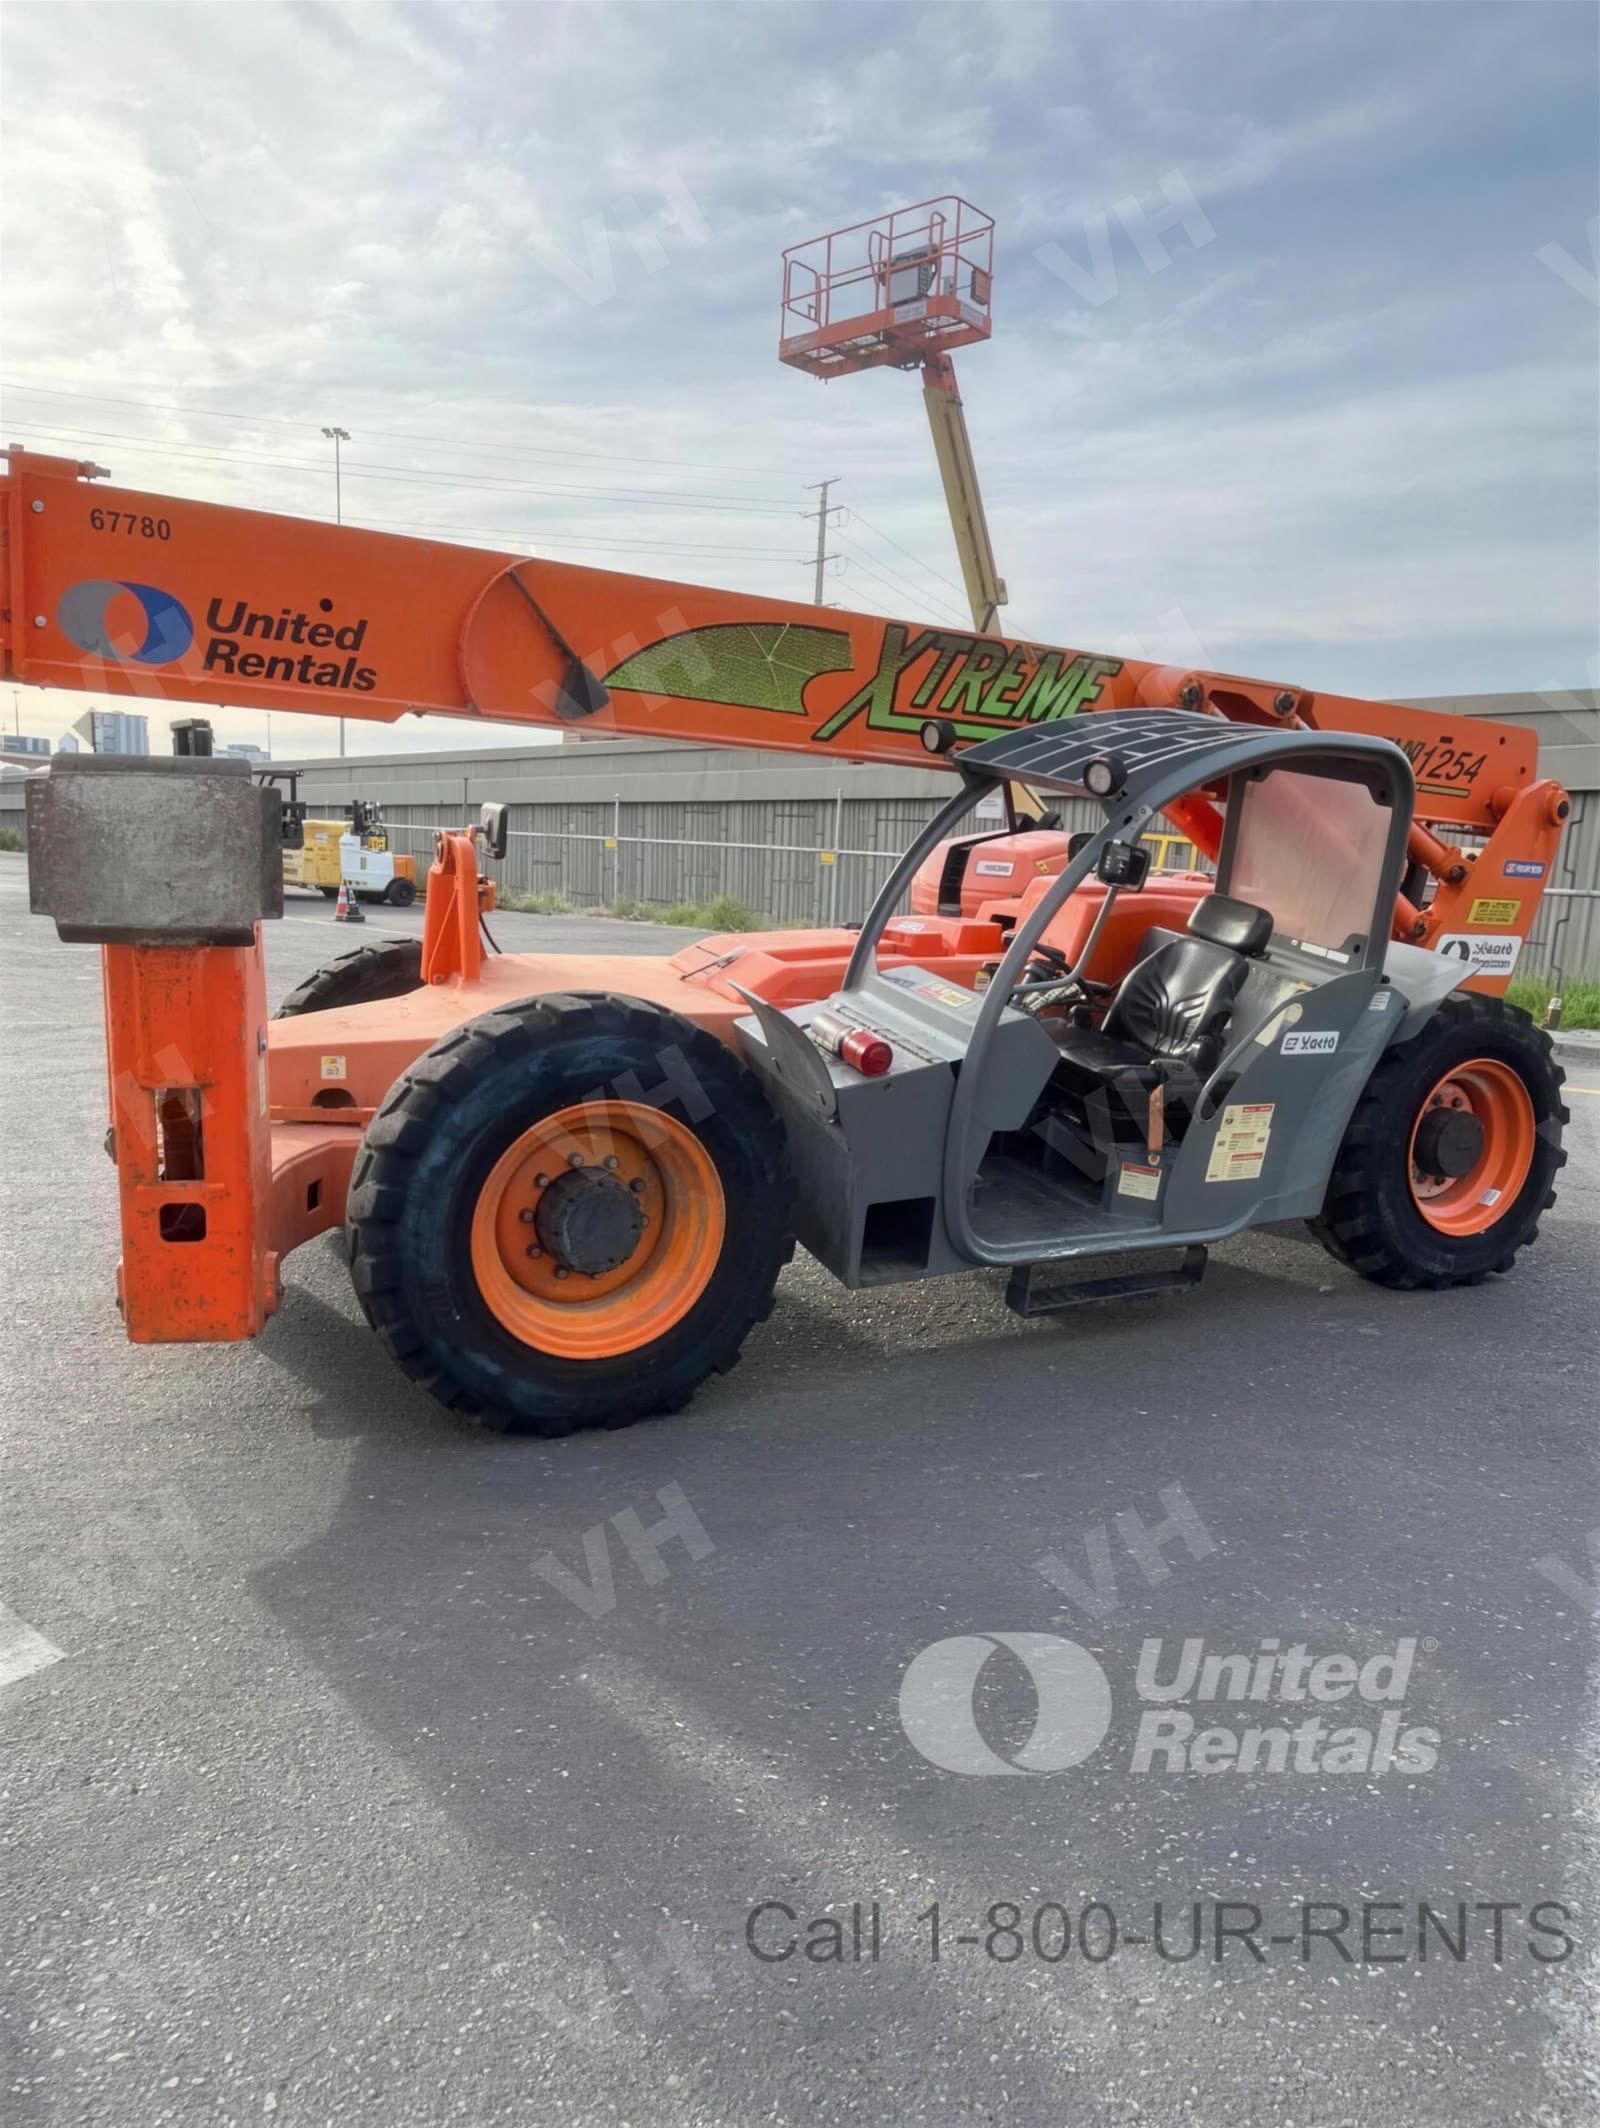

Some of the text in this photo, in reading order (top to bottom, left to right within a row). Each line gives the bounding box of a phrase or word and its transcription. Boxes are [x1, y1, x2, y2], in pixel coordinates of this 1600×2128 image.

[90, 508, 171, 541] 67780
[206, 598, 368, 652] United
[202, 638, 377, 692] Rentals
[811, 623, 1124, 741] XTREME
